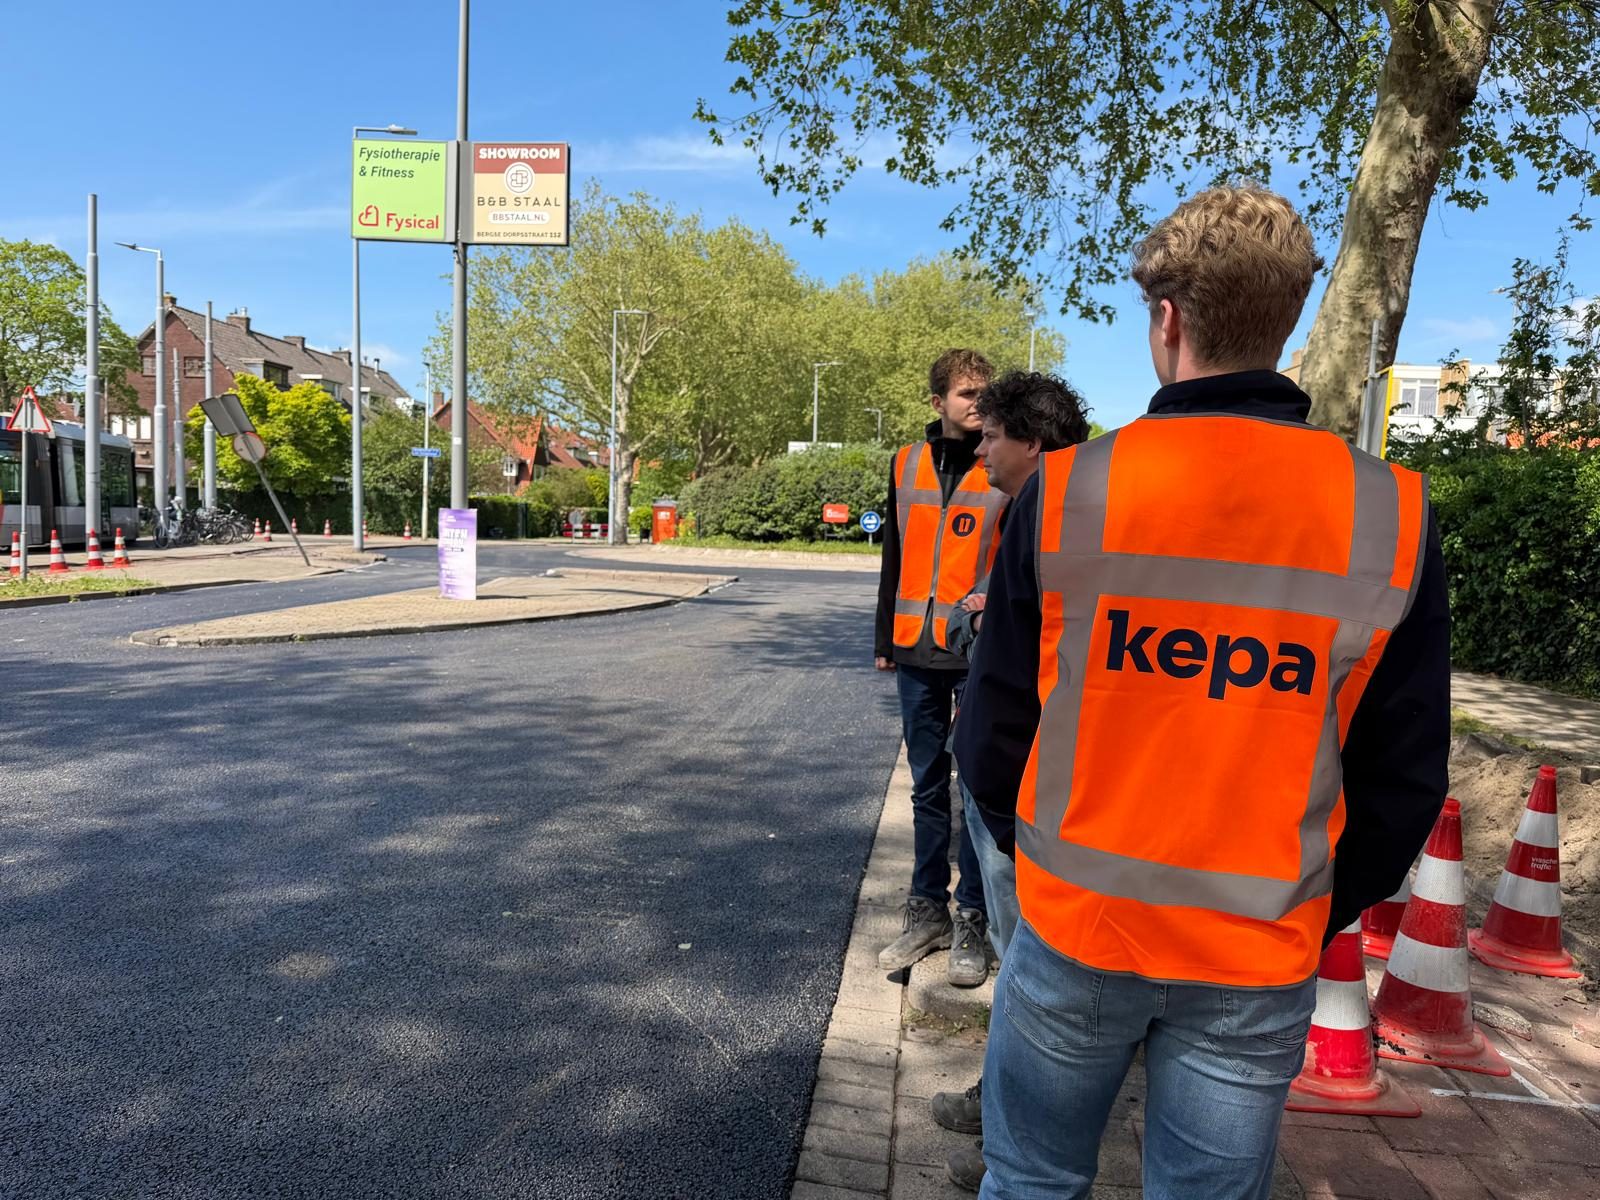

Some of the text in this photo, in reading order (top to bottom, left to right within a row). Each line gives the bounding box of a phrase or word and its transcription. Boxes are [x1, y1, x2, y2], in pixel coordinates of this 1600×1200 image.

[359, 147, 440, 163] Fysiotherapie
[479, 147, 560, 160] SHOWROOM
[359, 166, 415, 178] & Fitness
[477, 197, 561, 206] B&B STAAL
[386, 213, 439, 232] Fysical
[492, 213, 546, 221] BBSTAAL.NL
[1106, 609, 1316, 700] kepa
